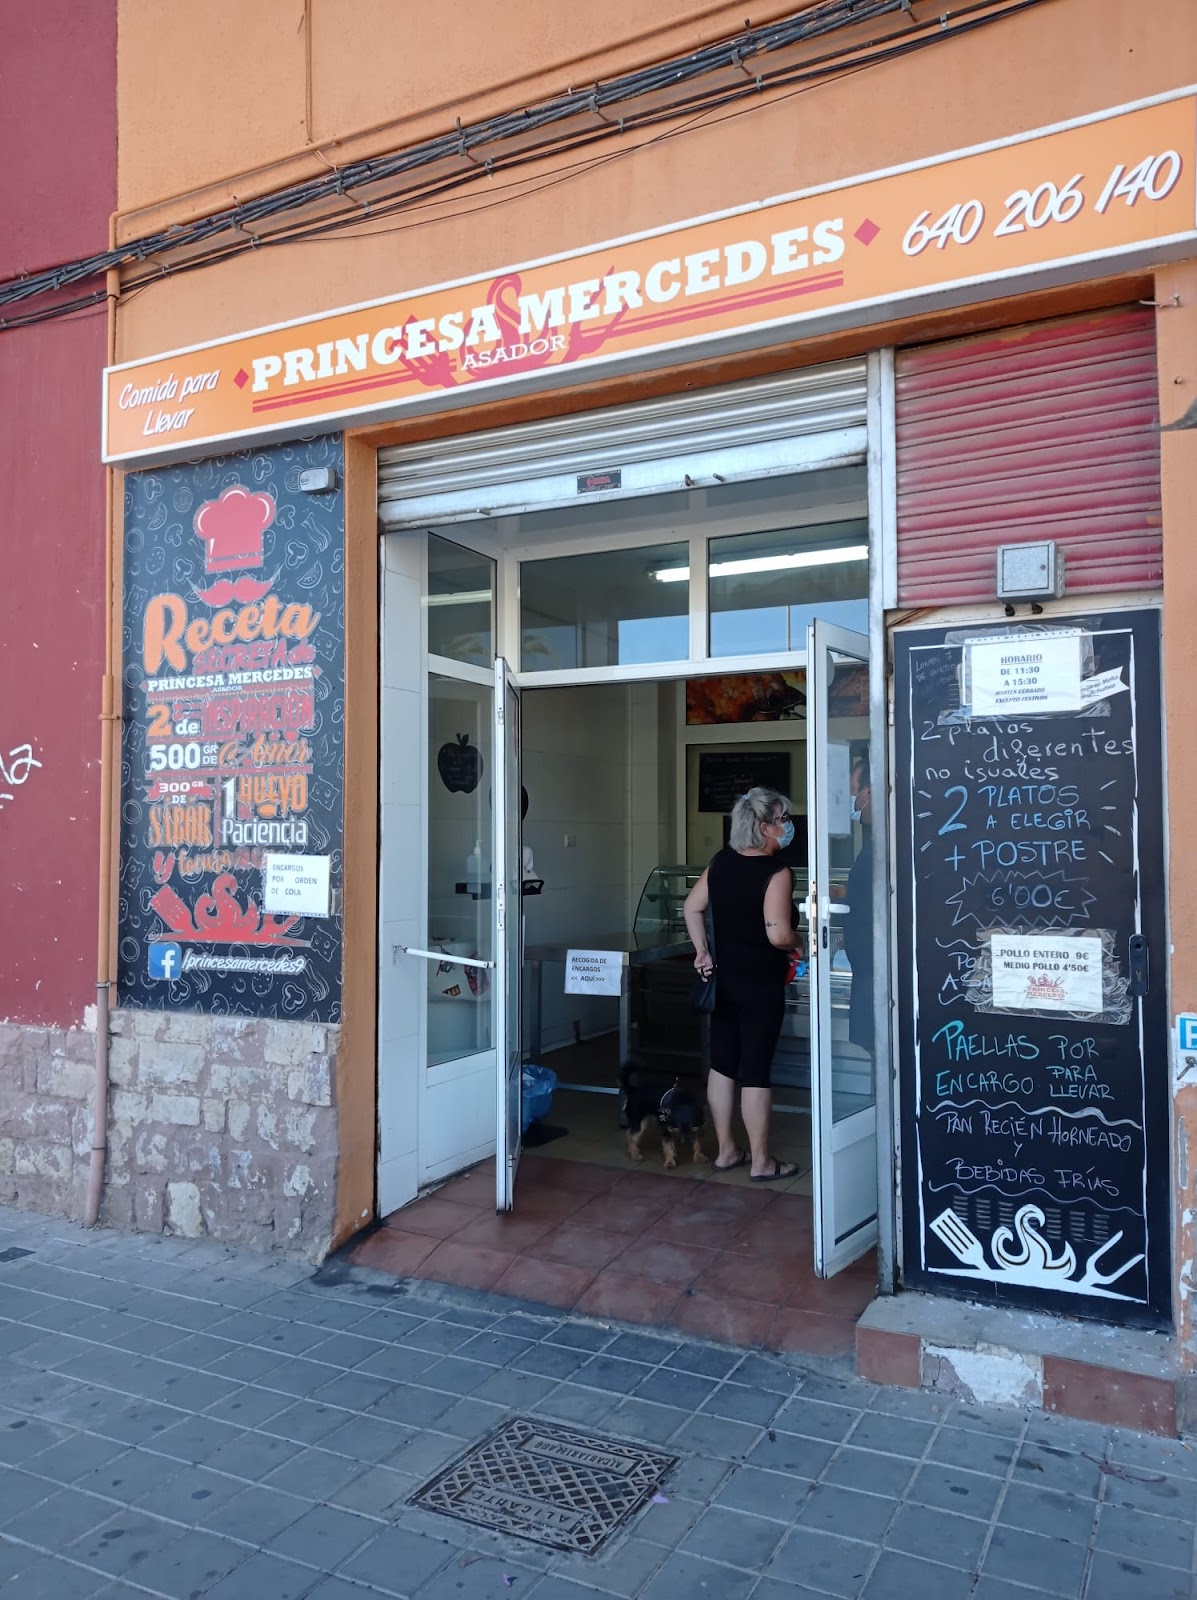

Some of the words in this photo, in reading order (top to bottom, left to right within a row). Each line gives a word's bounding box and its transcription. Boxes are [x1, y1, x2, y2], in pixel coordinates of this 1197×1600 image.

[902, 199, 984, 256] 640
[993, 173, 1086, 238] 206
[1094, 150, 1182, 214] 140
[252, 304, 501, 393] PRINCESA
[518, 217, 845, 336] MERCEDES
[460, 334, 567, 371] ASADOR
[119, 373, 179, 410] Comida
[179, 370, 221, 403] para
[143, 408, 195, 436] Llevar
[143, 594, 321, 675] Receta
[1000, 653, 1043, 664] HORARIO
[147, 673, 224, 693] PRINCESA
[228, 667, 312, 688] MERCEDES
[1000, 668, 1011, 676] DE
[1015, 666, 1040, 675] 11:30
[1003, 679, 1010, 687] A
[1012, 677, 1038, 686] 15:30
[212, 685, 242, 693] ASADOR
[148, 704, 172, 736] 2
[175, 719, 200, 735] de
[920, 721, 941, 741] 2
[949, 717, 1033, 744] platos
[150, 744, 201, 770] 500
[203, 745, 218, 754] GR
[203, 755, 218, 765] DE
[926, 767, 950, 780] no
[159, 783, 190, 793] 300
[192, 780, 204, 788] GR
[223, 778, 236, 819] 1
[240, 774, 308, 817] HUEVO
[978, 785, 1079, 807] PLATOS
[172, 795, 187, 804] DE
[938, 785, 969, 835] 2
[222, 817, 308, 845] Paciencia
[986, 813, 997, 829] A
[1010, 810, 1091, 830] ELEGIR
[971, 840, 1087, 869] POSTRE
[272, 863, 304, 872] ENCARGOS
[272, 875, 285, 883] POR
[295, 876, 318, 885] ORDEN
[285, 888, 302, 896] COLA
[571, 956, 599, 964] RECOGIDA
[1000, 949, 1030, 958] POLLO
[1033, 950, 1070, 959] ENTERO
[1076, 951, 1090, 960] 9€
[1003, 961, 1030, 970] MEDIO
[1032, 963, 1060, 971] POLLO
[1062, 963, 1090, 972] 4'50€
[571, 965, 601, 973] ENCARGOS
[932, 1020, 1039, 1061] PAELLAS
[1049, 1035, 1100, 1060] POR
[936, 1070, 1034, 1097] ENCARGO
[1046, 1065, 1098, 1082] PARA
[1050, 1083, 1115, 1101] LLEVAR
[936, 1111, 973, 1135] PAN
[1048, 1114, 1132, 1152] HORNEADO
[946, 1158, 1046, 1185] BEBIDAS
[471, 1489, 571, 1524] ALICANTE
